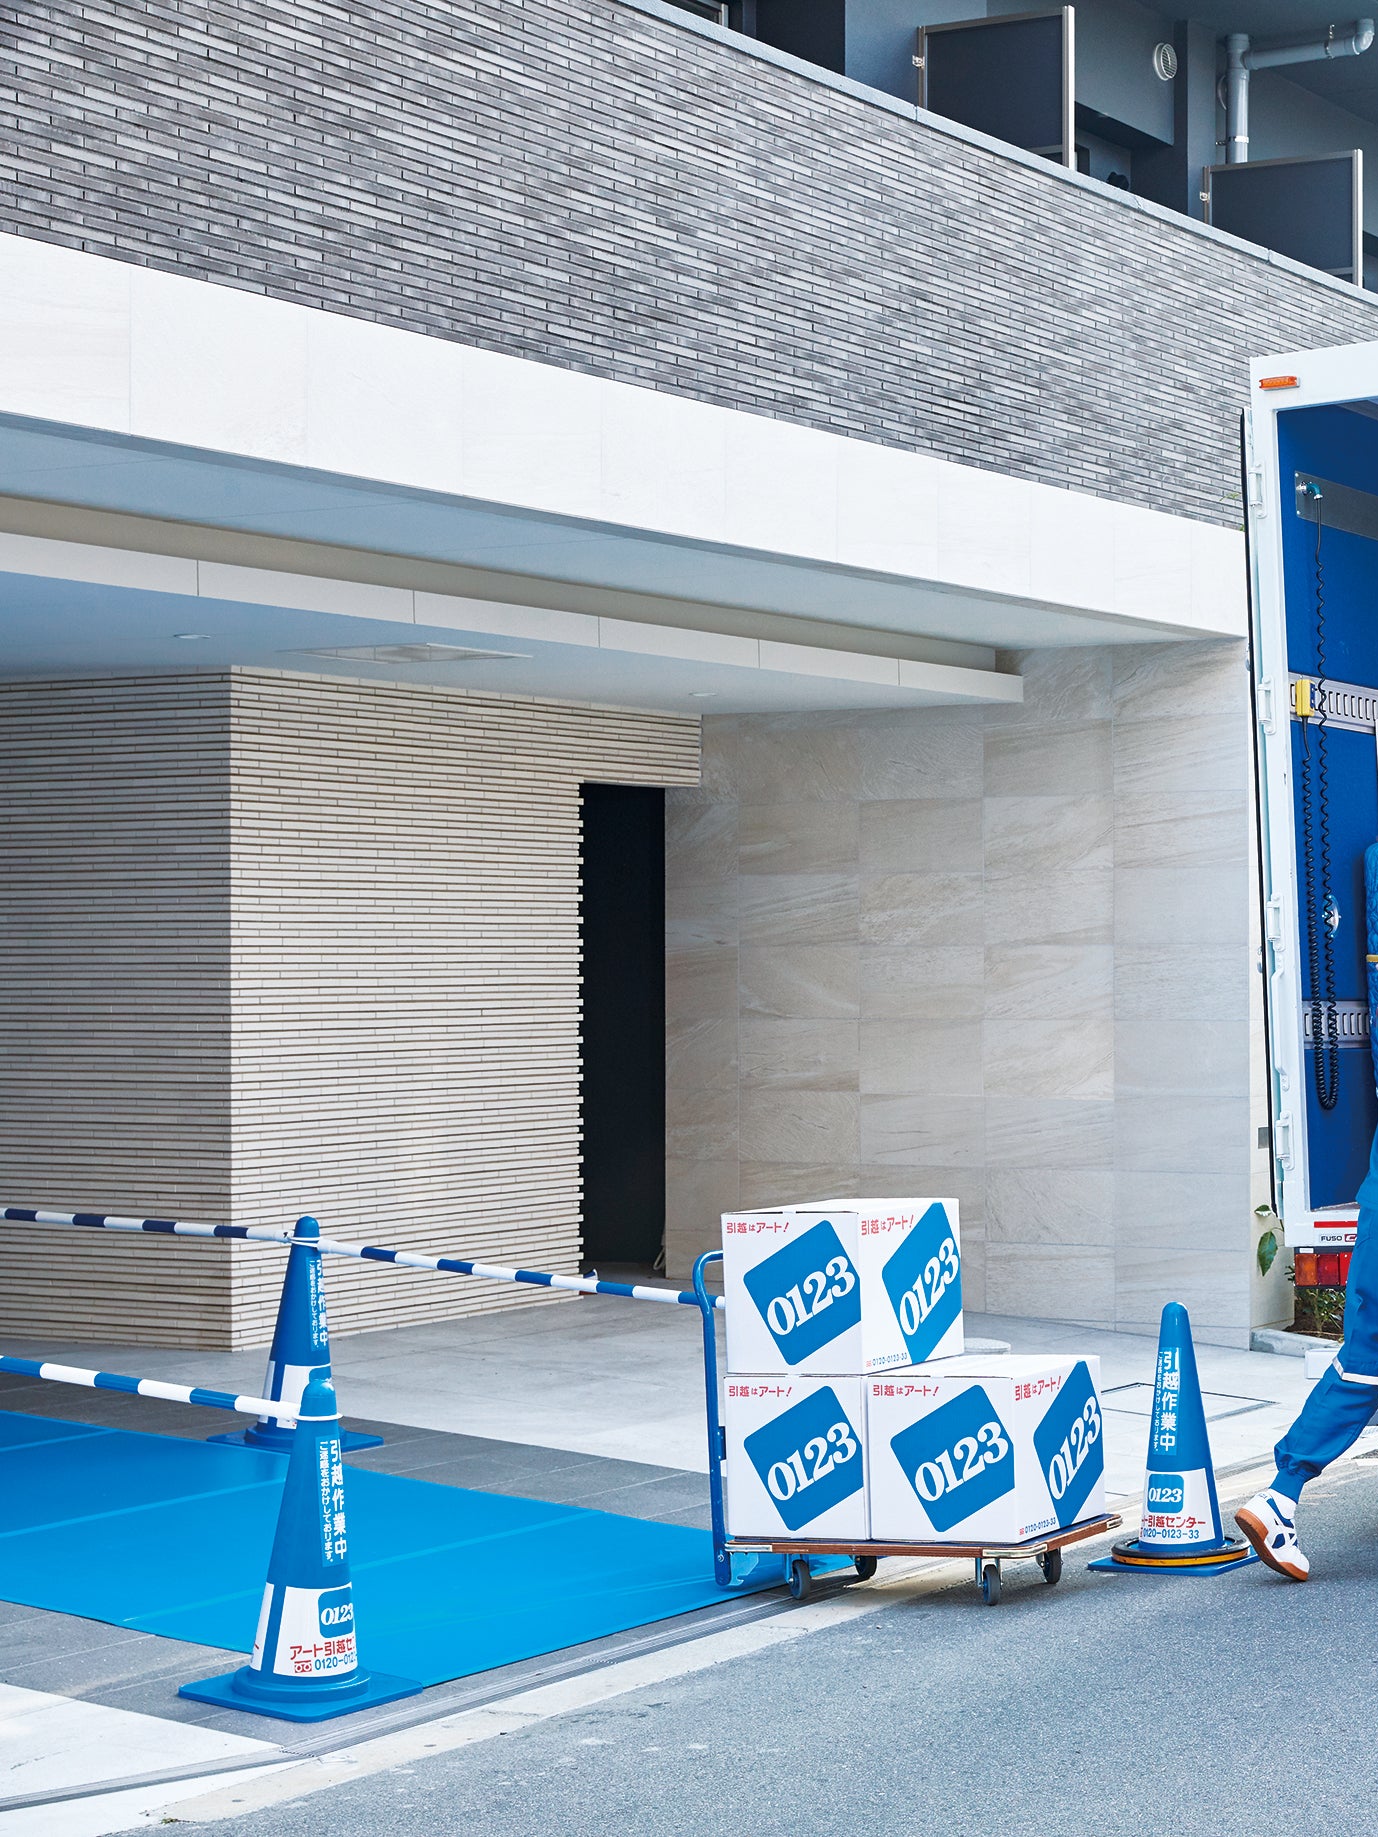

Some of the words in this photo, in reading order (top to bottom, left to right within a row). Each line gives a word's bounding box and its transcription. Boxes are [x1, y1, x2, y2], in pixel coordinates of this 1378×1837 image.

[726, 1222, 789, 1234] 引越はアート!
[861, 1215, 914, 1235] 引越はアート!
[767, 1256, 855, 1335] 0123
[900, 1237, 959, 1336] 0123
[872, 1352, 907, 1366] 0120-0123-33
[728, 1386, 792, 1398] 引越はアート!
[873, 1385, 939, 1397] 引越はアート!
[1015, 1375, 1062, 1401] 引越はアート!
[1160, 1349, 1180, 1451] 引越作業中
[1049, 1396, 1101, 1500] 0123
[767, 1422, 856, 1501] 0123
[914, 1421, 1009, 1501] 0123
[330, 1439, 347, 1559] 引越作業中
[1148, 1488, 1182, 1502] 0123
[1025, 1517, 1056, 1533] 0120-0123-33
[321, 1602, 353, 1625] 0123
[314, 1652, 356, 1670] 0120-012
